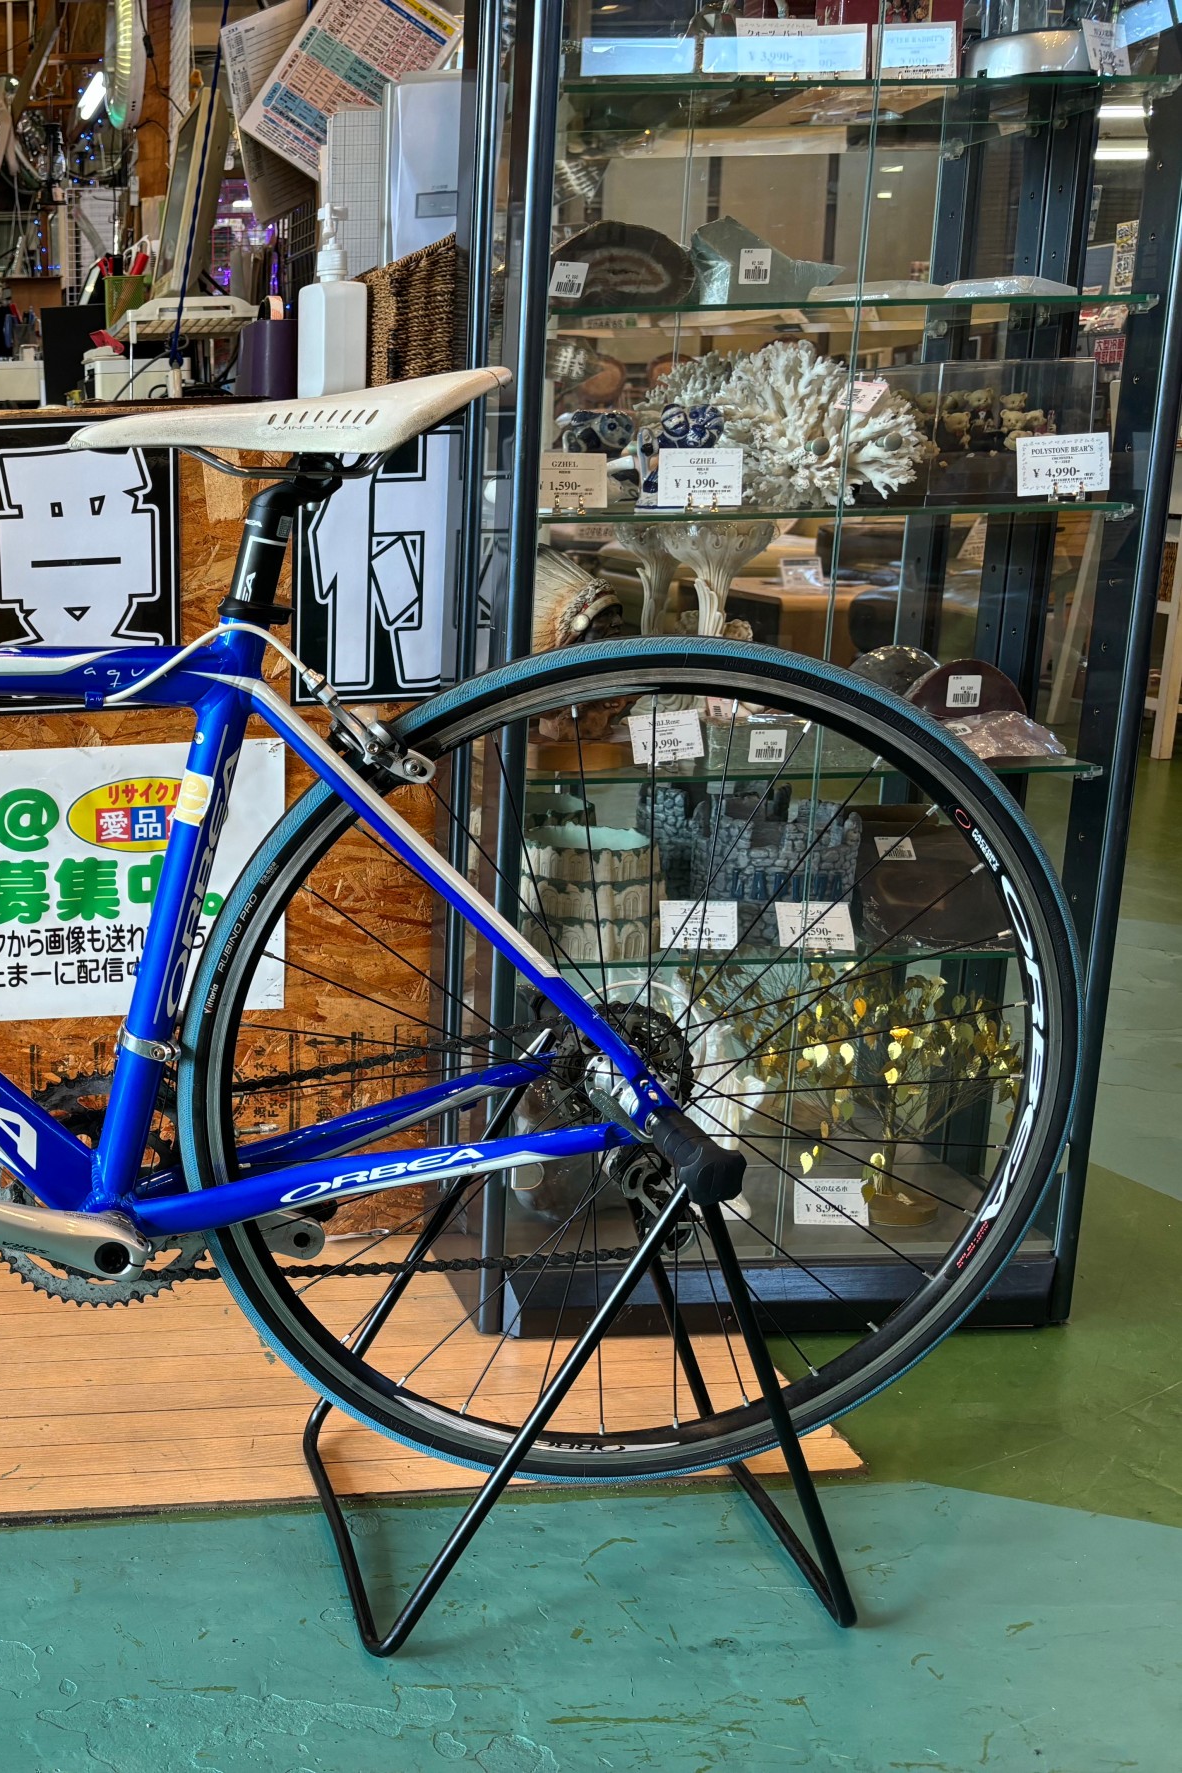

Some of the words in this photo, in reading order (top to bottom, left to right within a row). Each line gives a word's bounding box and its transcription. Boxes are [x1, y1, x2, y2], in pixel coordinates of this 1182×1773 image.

[1031, 447, 1070, 455] POLYSTONE
[1070, 444, 1094, 454] BEAR'S
[551, 460, 579, 468] GZHEL
[689, 457, 718, 465] GZHEL
[1033, 468, 1040, 478] ¥
[1044, 466, 1081, 479] 4,990-
[549, 480, 581, 491] 1,590-
[674, 478, 681, 488] ¥
[686, 478, 720, 489] 1,990-
[164, 747, 241, 1019] ORBEA
[217, 924, 242, 974] RUBINO
[240, 893, 258, 922] PRO
[790, 926, 796, 935] ¥
[802, 926, 832, 937] ,590-
[202, 983, 219, 1015] Vittoria
[980, 874, 1045, 1222] ORBEA
[279, 1147, 485, 1203] ORBEA
[805, 1203, 812, 1213] ¥
[2, 1241, 50, 1254] SORA
[533, 1439, 626, 1453] ORBE
